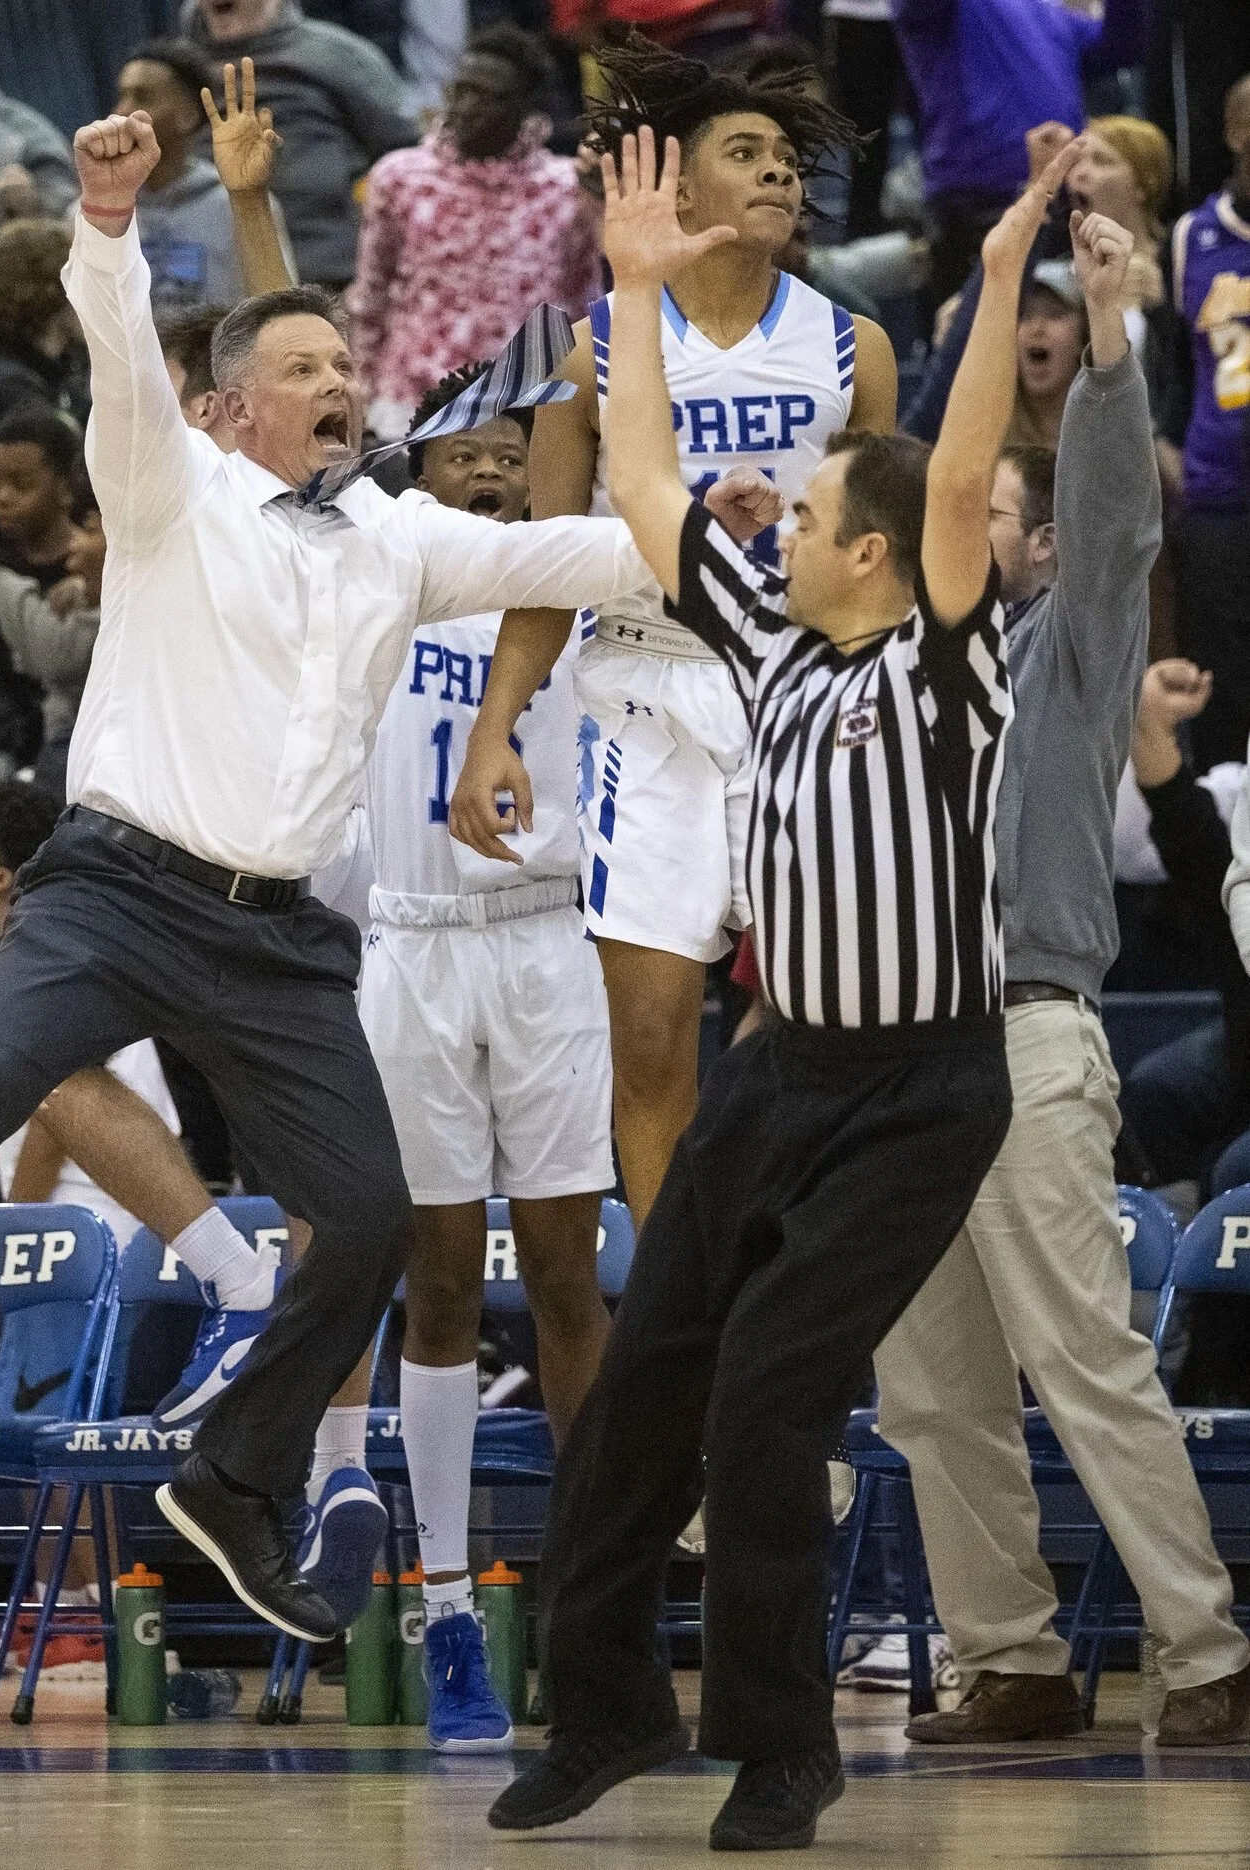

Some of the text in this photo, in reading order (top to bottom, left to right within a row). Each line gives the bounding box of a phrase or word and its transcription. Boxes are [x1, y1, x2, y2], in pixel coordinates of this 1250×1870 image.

[671, 395, 815, 453] REP
[409, 640, 551, 711] PR
[65, 1428, 193, 1451] JR. JAYS
[133, 1611, 162, 1646] G
